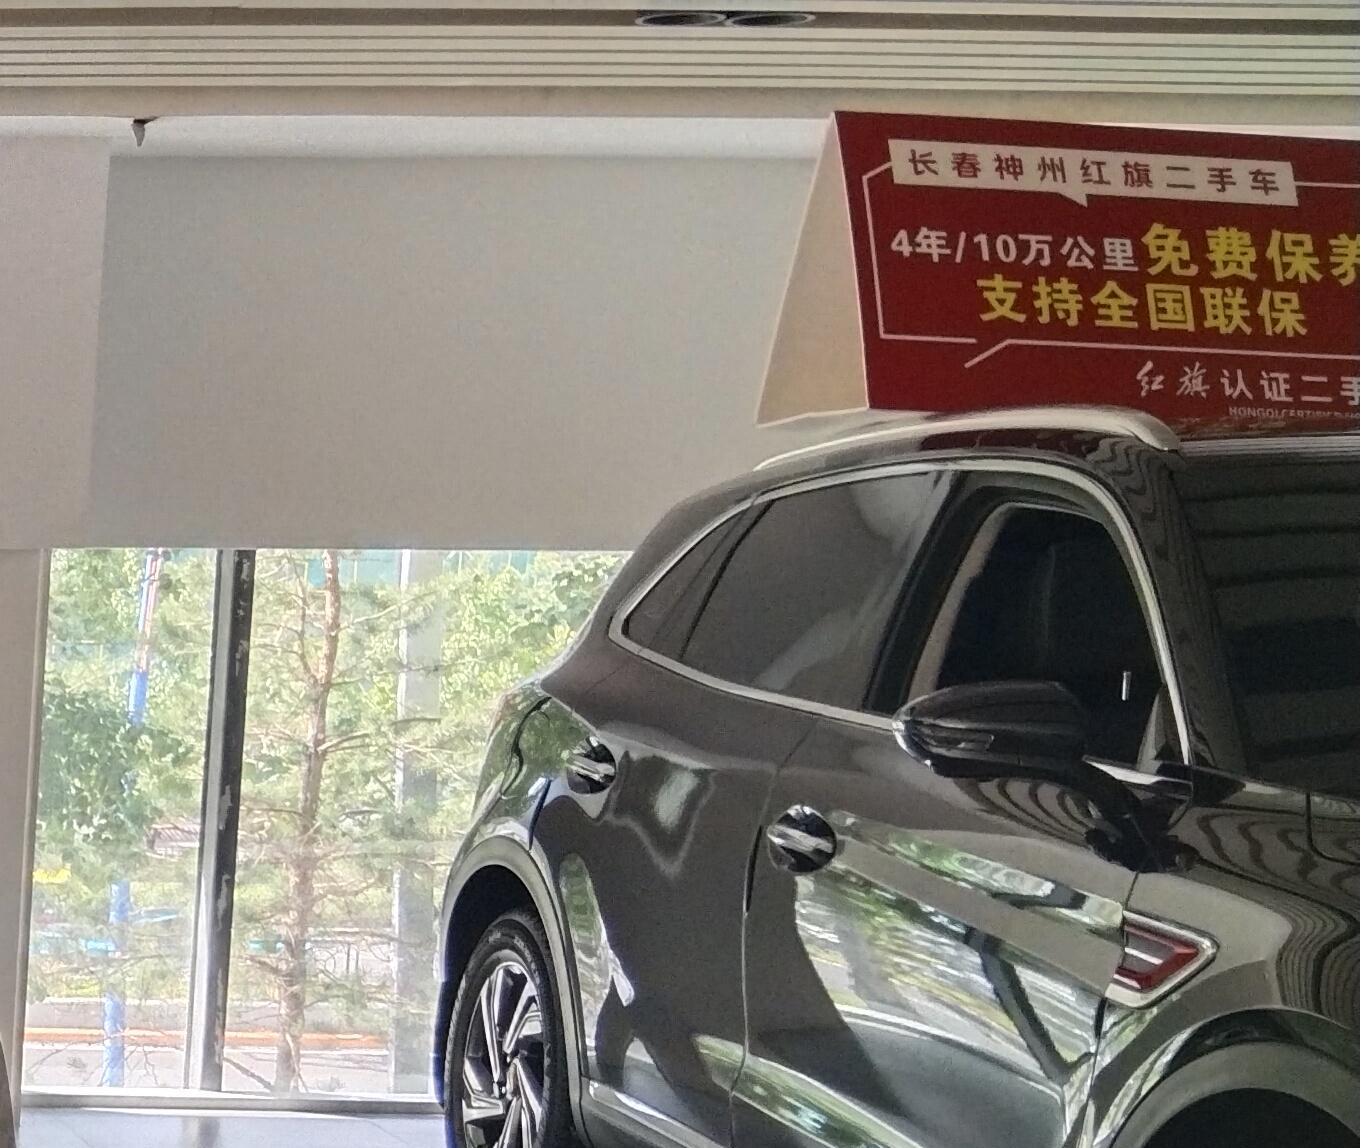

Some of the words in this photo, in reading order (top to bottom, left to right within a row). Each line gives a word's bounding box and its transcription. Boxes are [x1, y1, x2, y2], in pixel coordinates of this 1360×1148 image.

[908, 149, 1281, 195] 长春神州红旗二手车
[976, 273, 1308, 337] 支持全国联保
